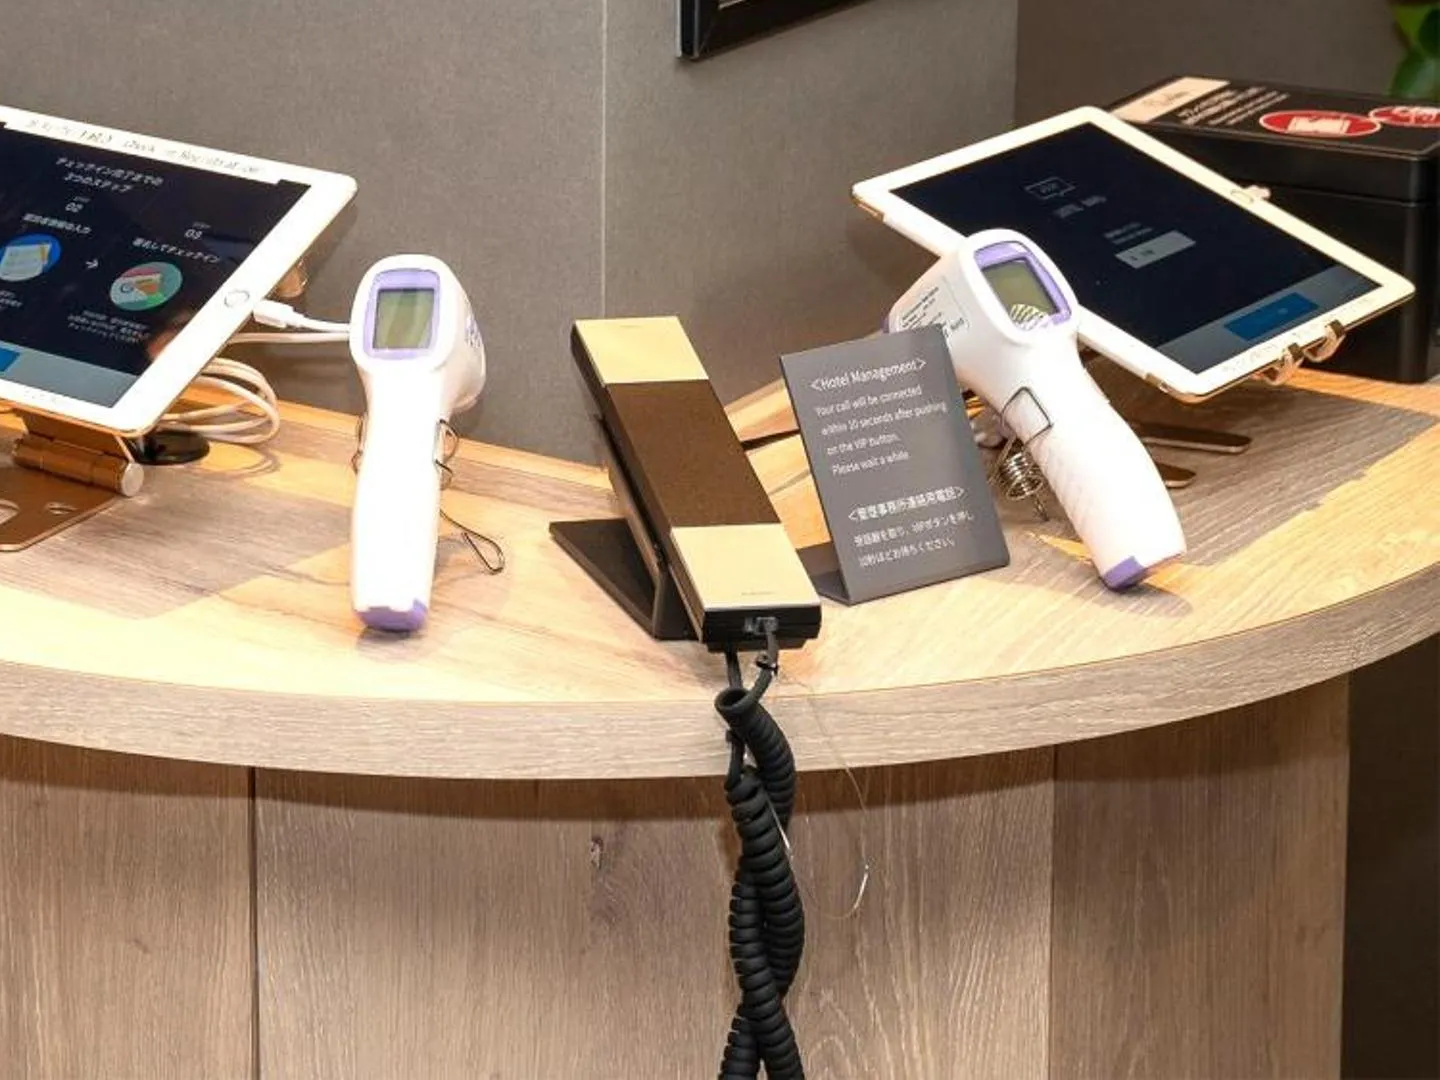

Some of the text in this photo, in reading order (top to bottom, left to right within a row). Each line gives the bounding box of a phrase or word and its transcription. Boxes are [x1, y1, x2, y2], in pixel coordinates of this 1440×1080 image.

[816, 405, 835, 417] Your
[836, 400, 851, 413] call
[868, 394, 878, 405] be
[879, 384, 923, 404] connected
[832, 461, 860, 476] Please
